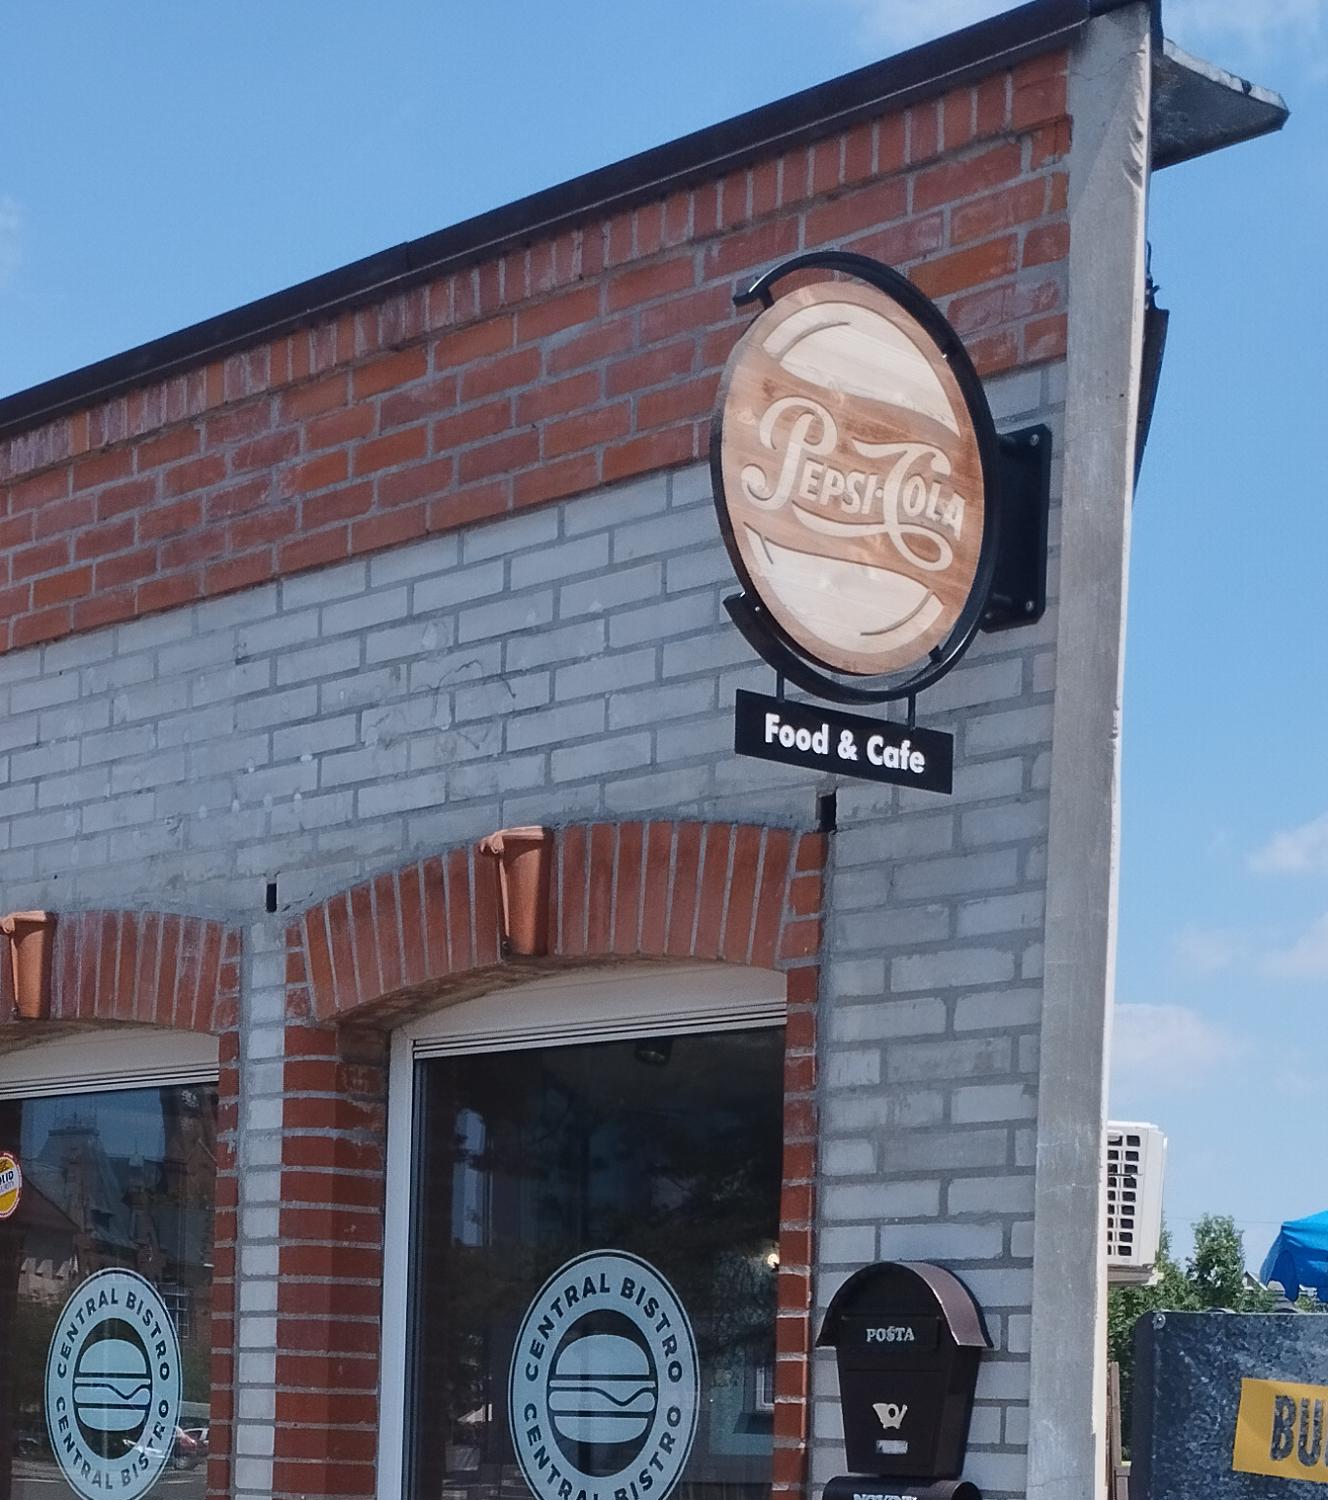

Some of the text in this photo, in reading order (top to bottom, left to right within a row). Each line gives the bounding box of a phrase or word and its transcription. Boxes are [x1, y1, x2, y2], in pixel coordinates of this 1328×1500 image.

[763, 712, 926, 775] Food & Cafe
[57, 1287, 170, 1382] CENTRAL BISTRO
[525, 1272, 683, 1383] CENTRAL BISTRO
[56, 1396, 169, 1490] CENTRAL BISTRO
